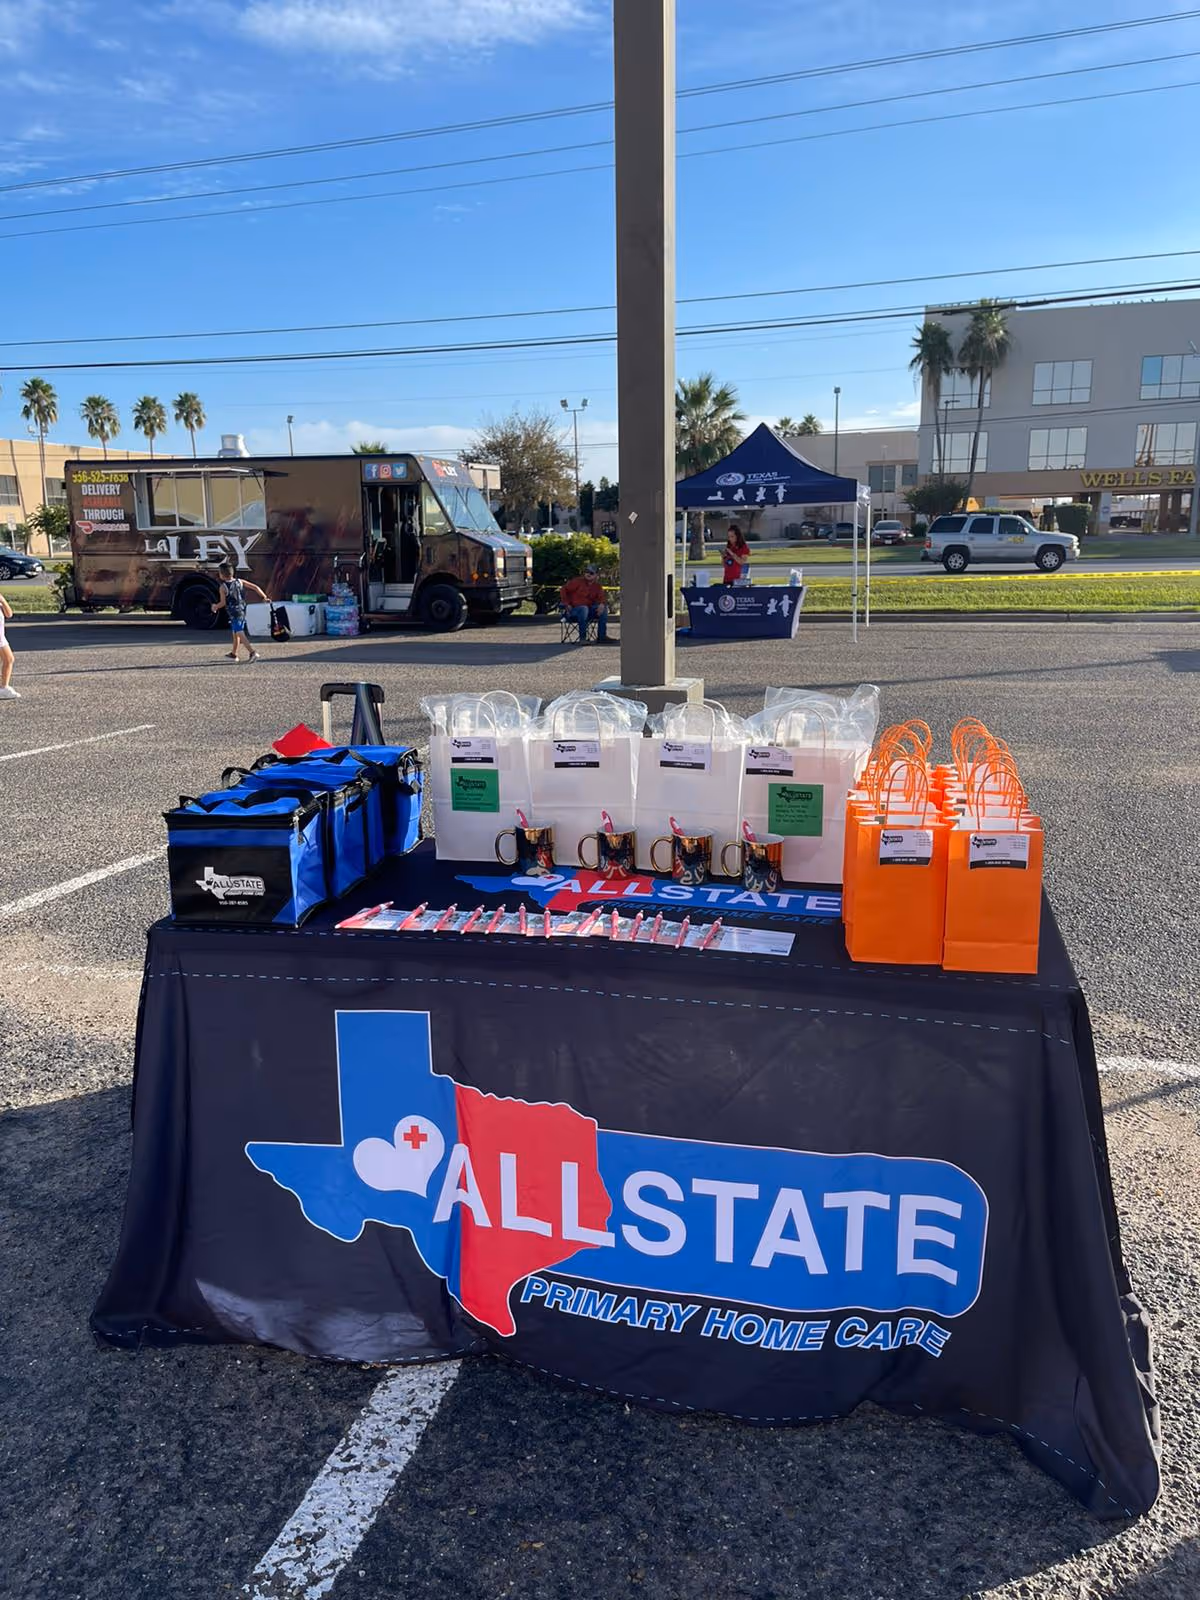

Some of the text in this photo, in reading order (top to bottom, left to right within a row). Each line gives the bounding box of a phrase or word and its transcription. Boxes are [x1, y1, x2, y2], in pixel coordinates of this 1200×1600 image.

[746, 472, 778, 480] TEXAS
[1081, 471, 1162, 488] WELLS
[81, 484, 121, 496] DELIVERY
[83, 508, 125, 521] THROUGH
[163, 532, 262, 571] LEY
[213, 879, 263, 889] ALLSTATE
[543, 879, 842, 912] ALLSTATE
[694, 908, 756, 920] HOME
[769, 914, 835, 926] CARE
[433, 1143, 963, 1286] ALLSTATE
[520, 1276, 952, 1358] PRIMARY HOME CARE
